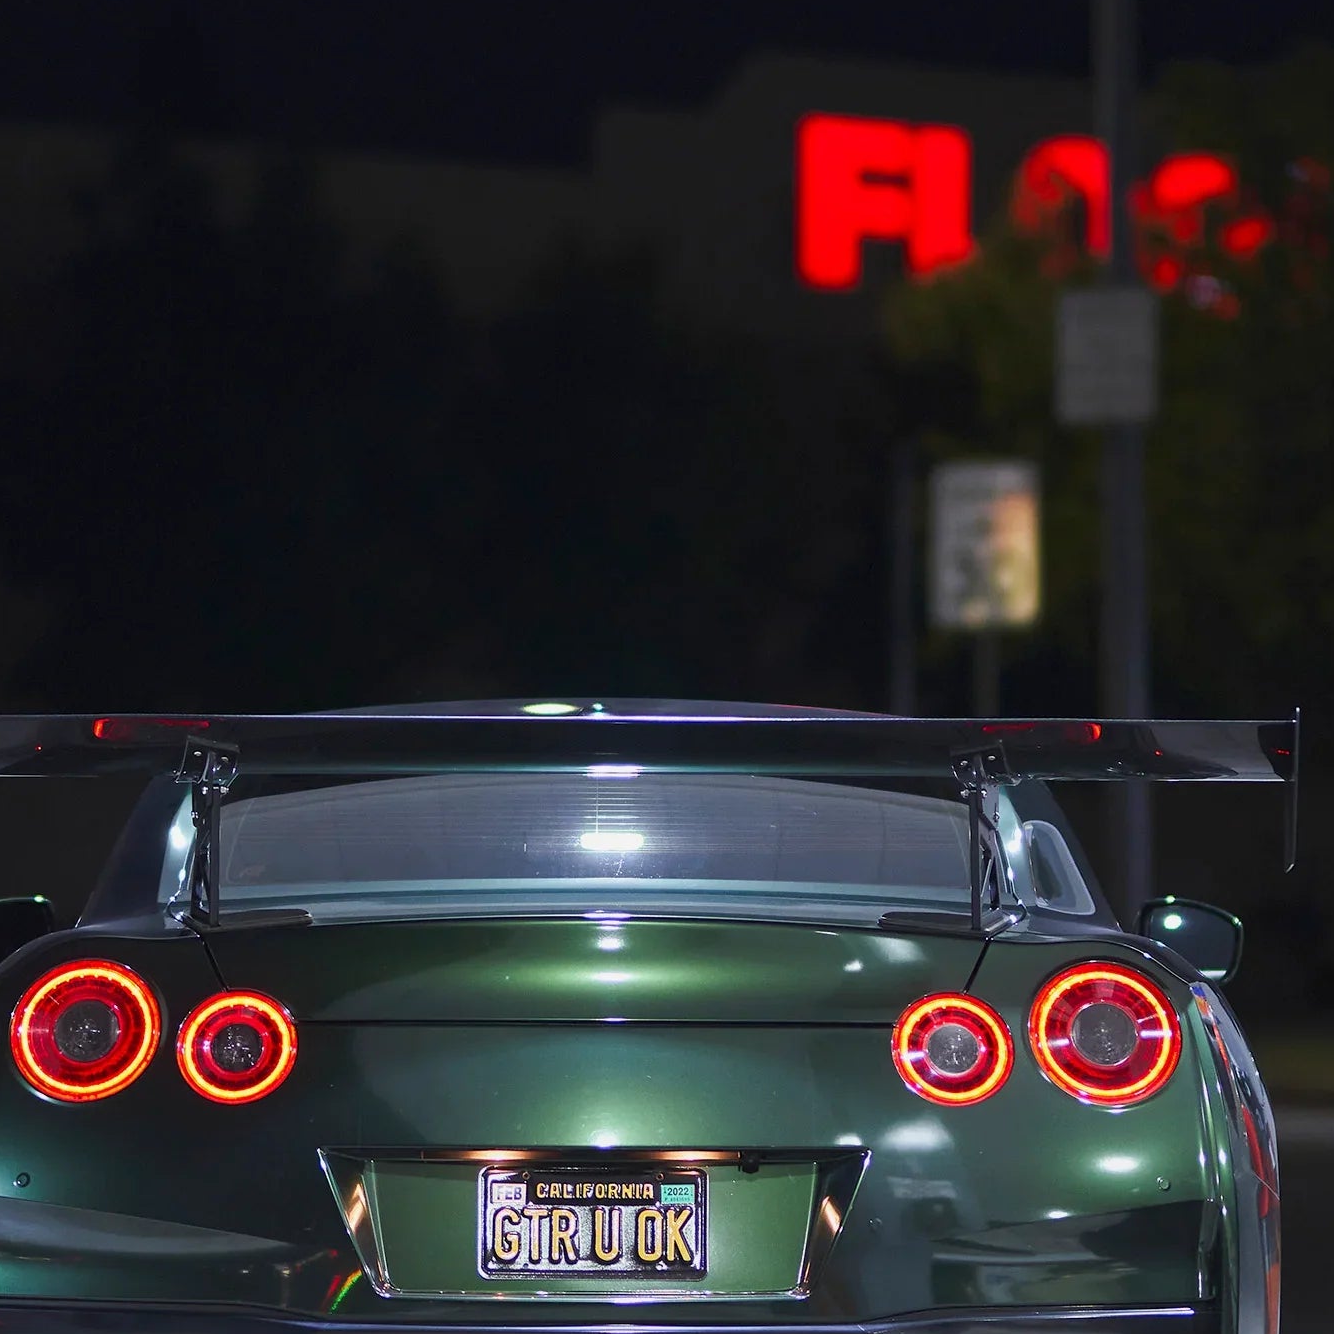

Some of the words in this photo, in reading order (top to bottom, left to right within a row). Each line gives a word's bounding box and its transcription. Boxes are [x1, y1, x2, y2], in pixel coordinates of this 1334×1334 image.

[496, 1185, 522, 1200] FEB
[536, 1182, 654, 1200] CALIFORNIA
[667, 1186, 689, 1196] 2022
[494, 1207, 577, 1262] GTR
[594, 1208, 620, 1262] U
[638, 1208, 691, 1262] OK
